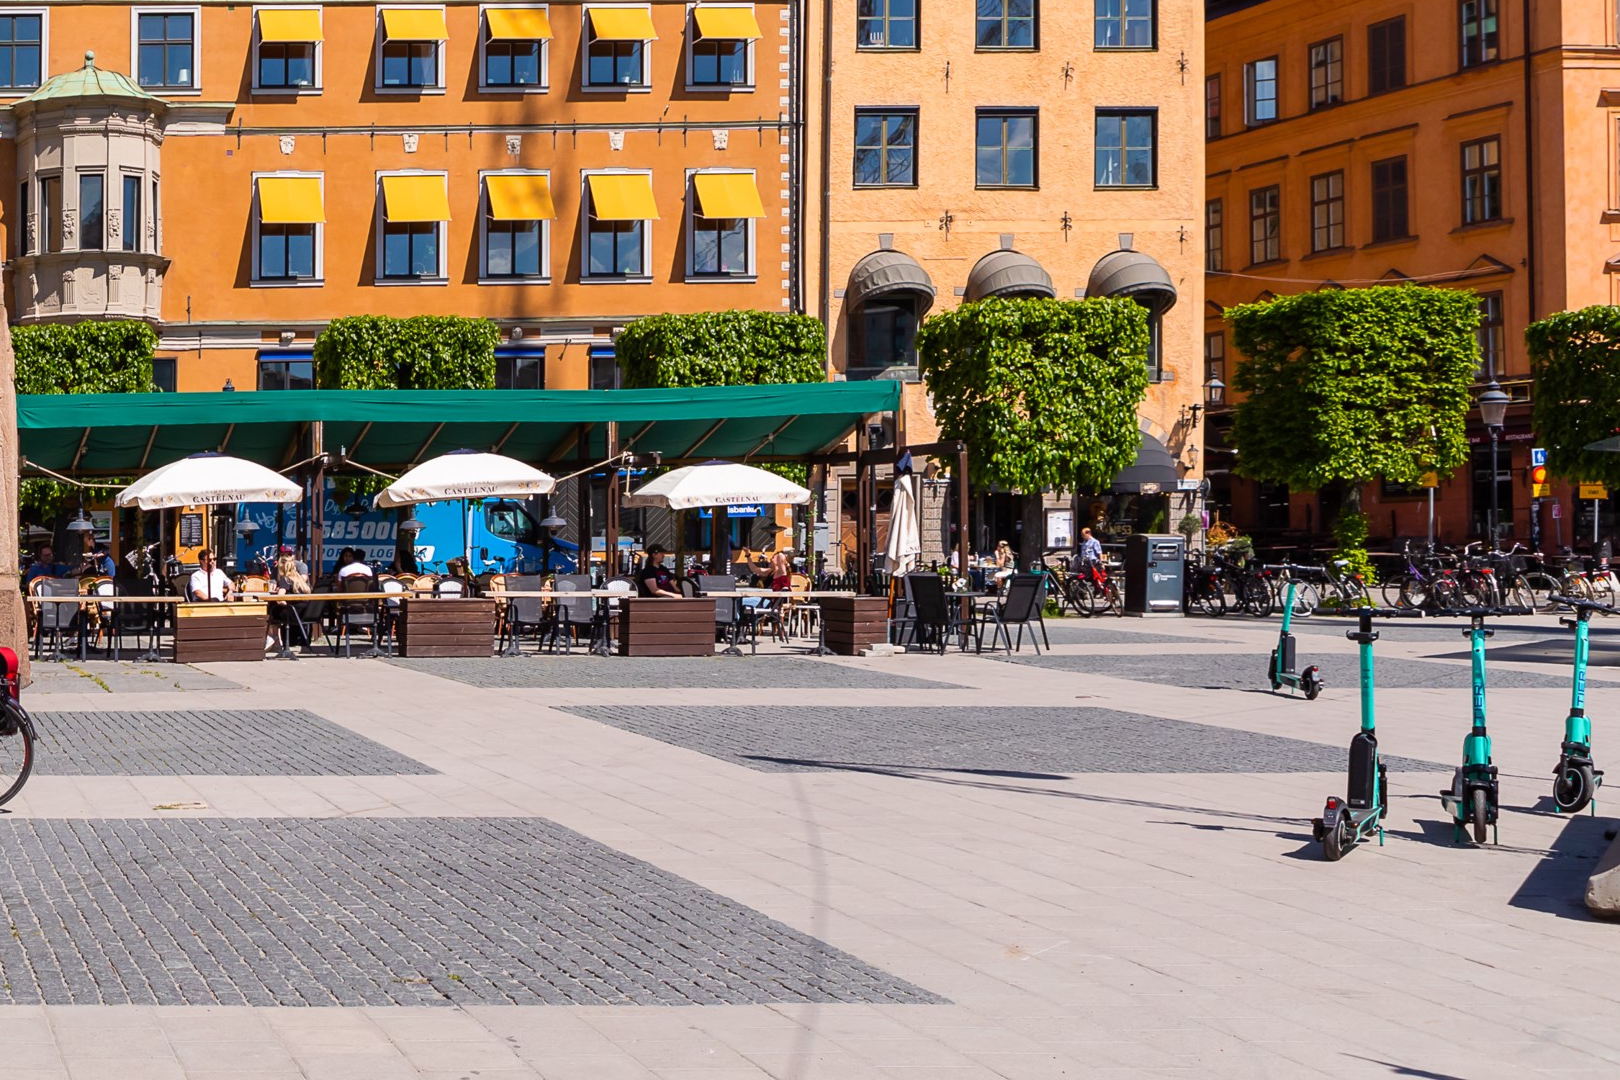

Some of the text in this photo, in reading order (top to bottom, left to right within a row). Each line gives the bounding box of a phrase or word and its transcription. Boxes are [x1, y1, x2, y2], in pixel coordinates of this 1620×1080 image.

[192, 493, 246, 503] CASTELNAU
[444, 485, 498, 495] CASTELNAU
[1577, 671, 1585, 706] TIER
[1474, 684, 1483, 723] TIER
